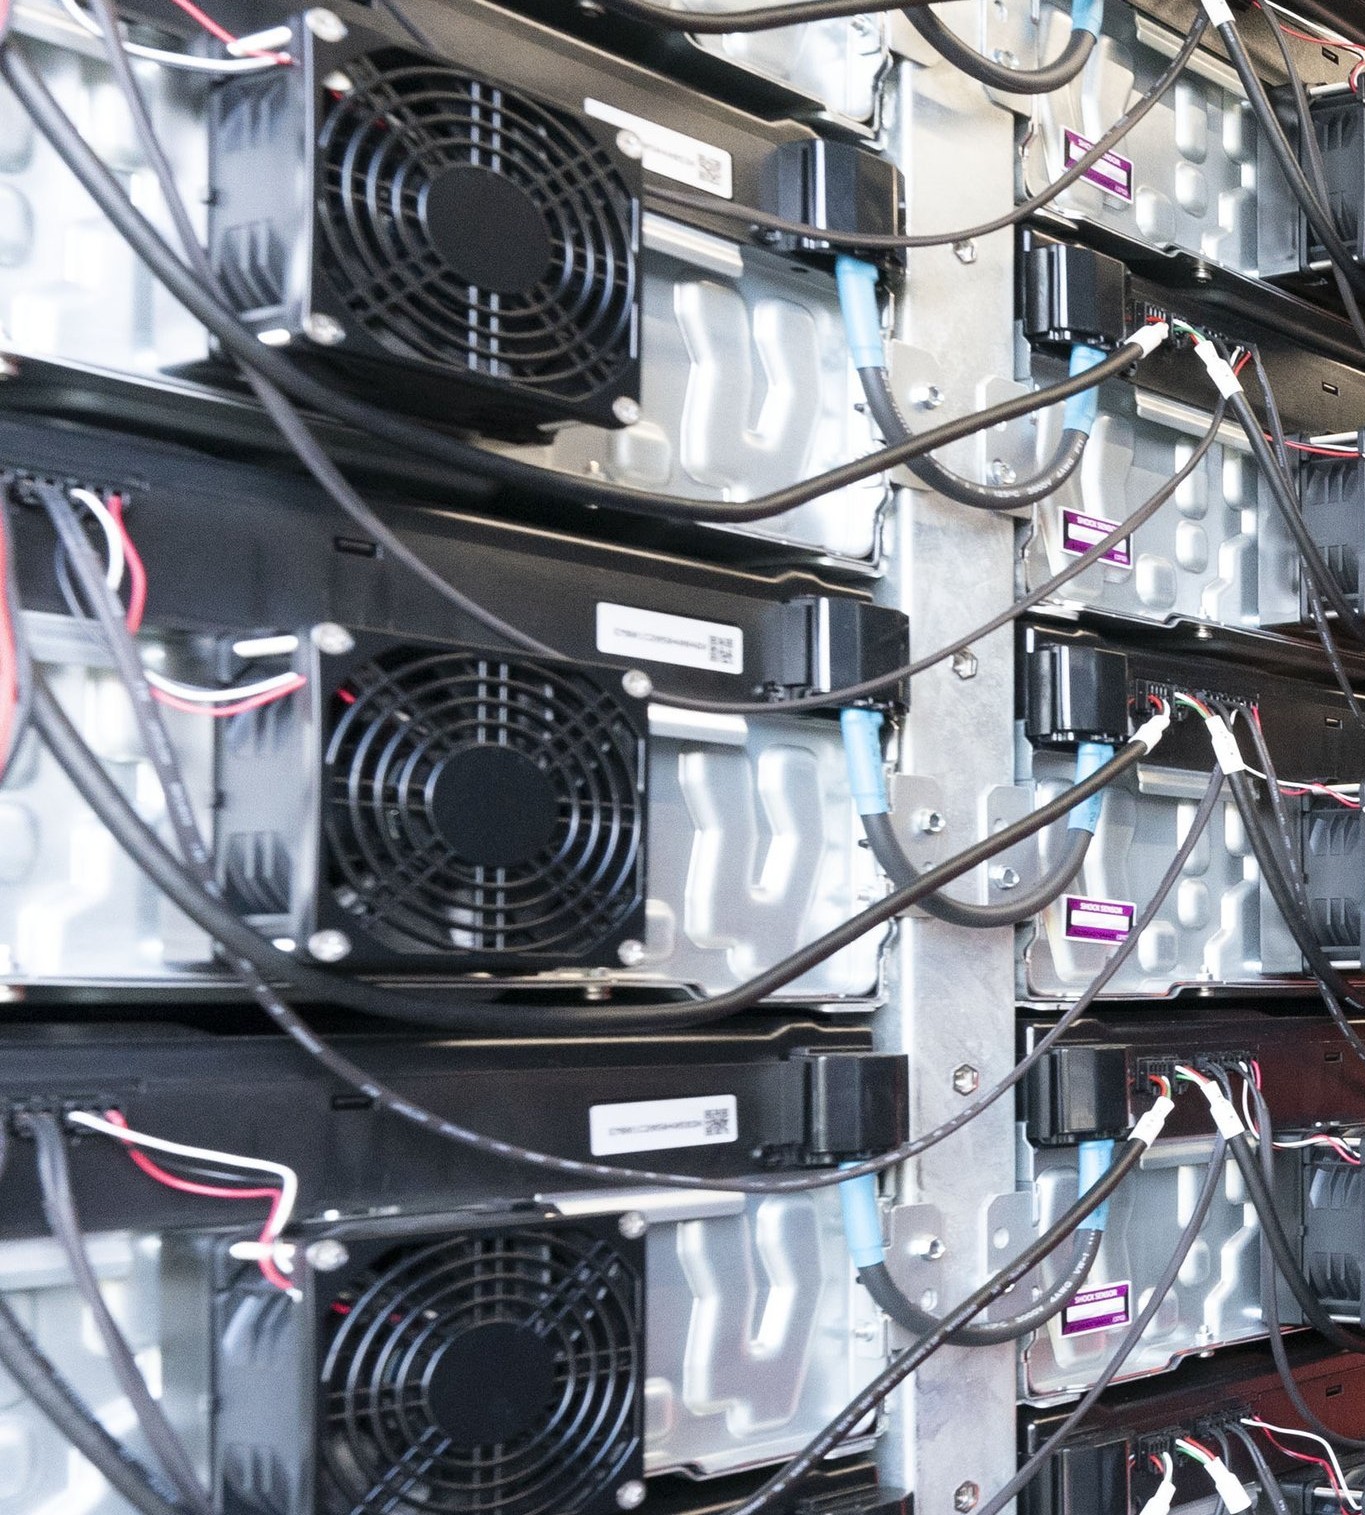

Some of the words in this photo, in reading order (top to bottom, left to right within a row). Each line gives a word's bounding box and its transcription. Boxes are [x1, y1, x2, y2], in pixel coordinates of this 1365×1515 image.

[1080, 902, 1101, 911] SHOCK
[1101, 905, 1123, 915] SENSOR
[1075, 1294, 1095, 1304] SHOCK
[1096, 1289, 1118, 1300] SENSOR
